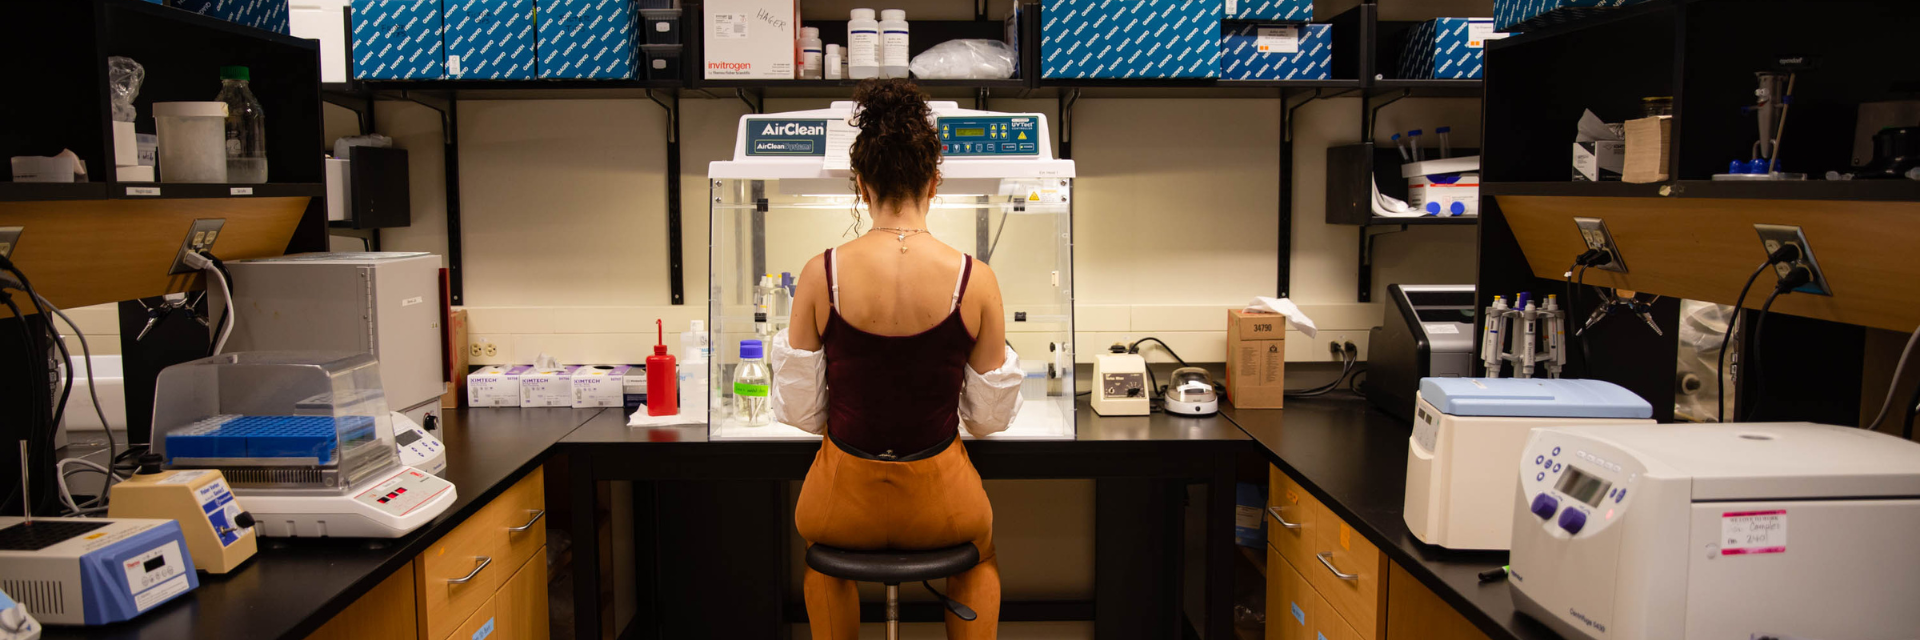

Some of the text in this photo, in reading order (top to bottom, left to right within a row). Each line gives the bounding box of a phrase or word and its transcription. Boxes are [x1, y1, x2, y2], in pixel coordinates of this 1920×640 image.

[361, 0, 375, 15] QIAGEN
[392, 5, 406, 19] QIAGEN
[444, 4, 458, 18] QIAGEN
[494, 1, 507, 15] QIAGEN
[546, 0, 560, 13] QIAGEN
[577, 3, 591, 18] QIAGEN
[1082, 2, 1096, 16] QIAGEN
[1131, 0, 1145, 13] QIAGEN
[1162, 4, 1175, 18] QIAGEN
[1256, 1, 1270, 14] QIAGEN
[1285, 6, 1299, 20] QIAGEN
[373, 12, 387, 26] QIAGEN
[423, 9, 436, 24] QIAGEN
[475, 8, 488, 23] QIAGEN
[506, 13, 519, 27] QIAGEN
[558, 11, 572, 25] QIAGEN
[608, 8, 622, 22] QIAGEN
[756, 8, 786, 31] HAGER
[1062, 10, 1076, 24] QIAGEN
[1093, 14, 1107, 28] QIAGEN
[1112, 7, 1126, 21] QIAGEN
[1143, 11, 1157, 25] QIAGEN
[1192, 8, 1206, 23] QIAGEN
[354, 20, 368, 34] QIAGEN
[404, 17, 418, 31] QIAGEN
[456, 16, 470, 30] QIAGEN
[487, 20, 500, 35] QIAGEN
[539, 18, 553, 33] QIAGEN
[589, 15, 602, 29] QIAGEN
[1044, 17, 1057, 31] QIAGEN
[1074, 21, 1088, 35] QIAGEN
[1124, 18, 1138, 33] QIAGEN
[1173, 16, 1187, 30] QIAGEN
[1203, 20, 1217, 34] QIAGEN
[1454, 22, 1468, 36] QIAGEN
[385, 24, 399, 38] QIAGEN
[416, 29, 430, 43] QIAGEN
[468, 28, 482, 42] QIAGEN
[518, 25, 531, 39] QIAGEN
[570, 22, 584, 37] QIAGEN
[601, 27, 614, 41] QIAGEN
[1055, 29, 1069, 43] QIAGEN
[1105, 26, 1119, 40] QIAGEN
[1154, 23, 1168, 37] QIAGEN
[1184, 28, 1198, 42] QIAGEN
[1435, 29, 1449, 43] QIAGEN
[366, 32, 380, 46] QIAGEN
[397, 36, 411, 50] QIAGEN
[450, 35, 463, 50] QIAGEN
[499, 32, 512, 46] QIAGEN
[551, 30, 565, 44] QIAGEN
[582, 34, 596, 49] QIAGEN
[1086, 33, 1100, 47] QIAGEN
[1135, 30, 1149, 44] QIAGEN
[1166, 35, 1180, 49] QIAGEN
[378, 43, 392, 58] QIAGEN
[428, 41, 442, 55] QIAGEN
[480, 40, 494, 54] QIAGEN
[511, 44, 524, 58] QIAGEN
[563, 42, 577, 56] QIAGEN
[613, 39, 626, 53] QIAGEN
[1067, 40, 1080, 54] QIAGEN
[1097, 45, 1111, 59] QIAGEN
[1116, 38, 1130, 52] QIAGEN
[1147, 42, 1161, 56] QIAGEN
[1196, 40, 1210, 53] QIAGEN
[1234, 41, 1247, 54] QIAGEN
[1309, 43, 1322, 56] QIAGEN
[1446, 41, 1460, 54] QIAGEN
[360, 51, 373, 65] QIAGEN
[409, 48, 423, 62] QIAGEN
[462, 47, 475, 62] QIAGEN
[492, 52, 506, 66] QIAGEN
[544, 49, 558, 64] QIAGEN
[594, 46, 608, 61] QIAGEN
[1048, 48, 1062, 62] QIAGEN
[1078, 52, 1092, 66] QIAGEN
[1128, 49, 1142, 63] QIAGEN
[1177, 47, 1191, 61] QIAGEN
[1207, 51, 1221, 65] QIAGEN
[1245, 52, 1258, 66] QIAGEN
[1292, 50, 1305, 63] QIAGEN
[1457, 52, 1471, 66] QIAGEN
[390, 55, 404, 70] QIAGEN
[421, 60, 435, 74] QIAGEN
[474, 59, 487, 74] QIAGEN
[575, 54, 588, 68] QIAGEN
[606, 58, 620, 72] QIAGEN
[708, 61, 751, 72] invitrogen
[1059, 60, 1073, 74] QIAGEN
[1109, 57, 1123, 71] QIAGEN
[1139, 61, 1154, 75] QIAGEN
[1158, 54, 1172, 68] QIAGEN
[1189, 58, 1203, 72] QIAGEN
[1227, 59, 1240, 73] QIAGEN
[1273, 57, 1287, 70] QIAGEN
[1302, 61, 1316, 75] QIAGEN
[1438, 59, 1452, 73] QIAGEN
[372, 63, 385, 77] QIAGEN
[504, 64, 518, 78] QIAGEN
[556, 61, 570, 76] QIAGEN
[1090, 64, 1104, 78] QIAGEN
[1256, 64, 1269, 77] QIAGEN
[1468, 64, 1481, 78] QIAGEN
[761, 123, 824, 136] AirClean
[1253, 324, 1272, 332] 34790
